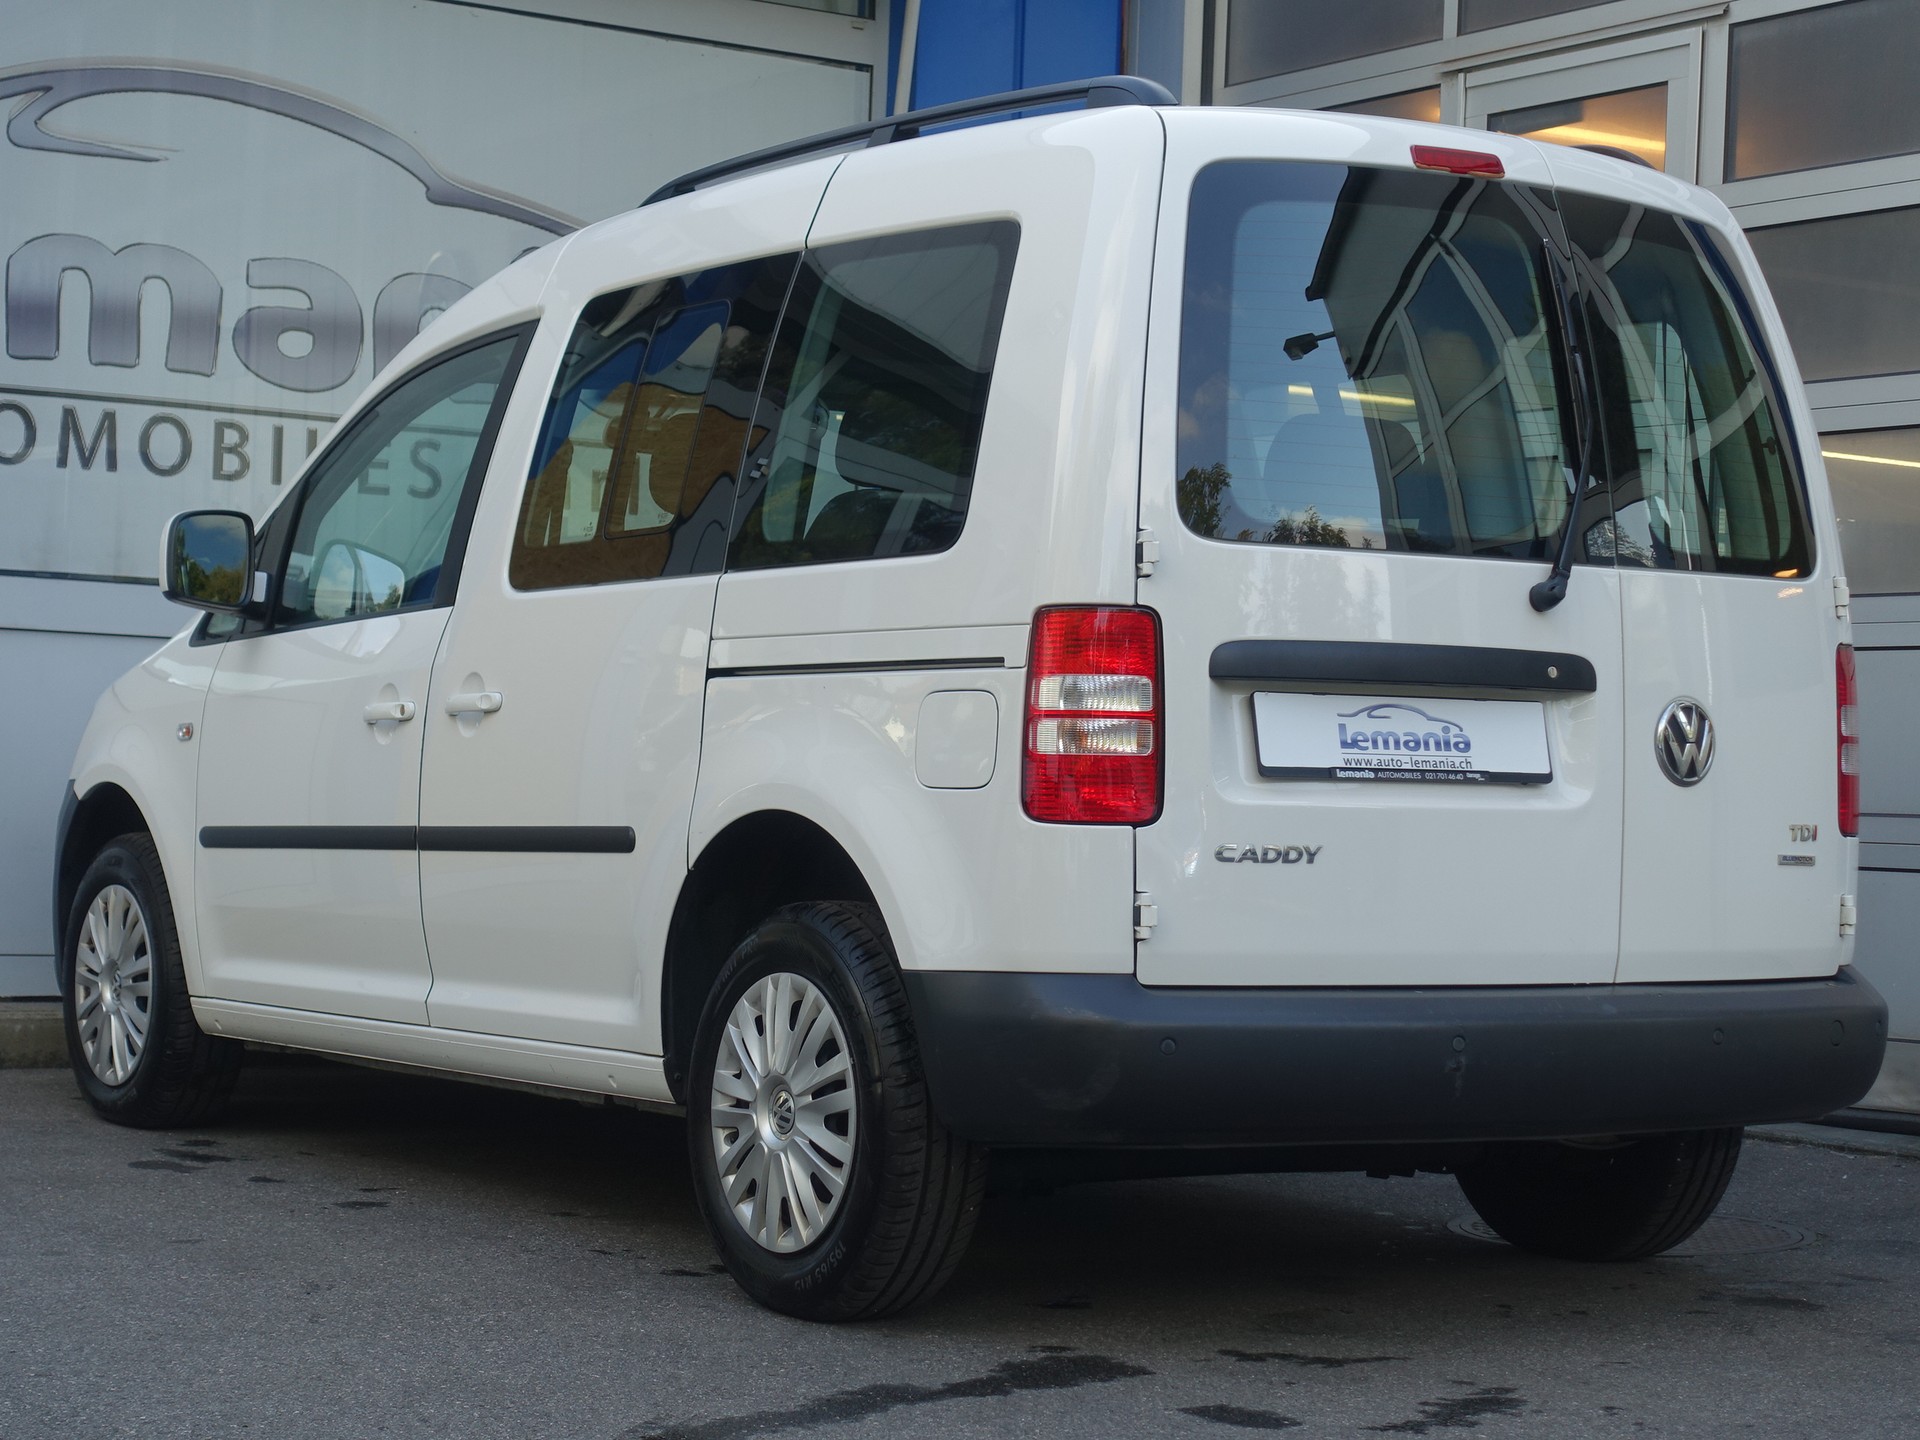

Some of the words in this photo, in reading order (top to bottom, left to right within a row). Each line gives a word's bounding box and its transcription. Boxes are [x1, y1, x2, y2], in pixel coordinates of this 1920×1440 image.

[5, 233, 542, 393] man
[0, 399, 442, 499] OMOBIES
[1338, 723, 1472, 753] Lemania
[1343, 757, 1472, 770] www.auto-lemania.ch
[1377, 771, 1421, 779] AUTOMOBILES
[1789, 824, 1818, 842] TDI
[1213, 843, 1324, 865] CADDY
